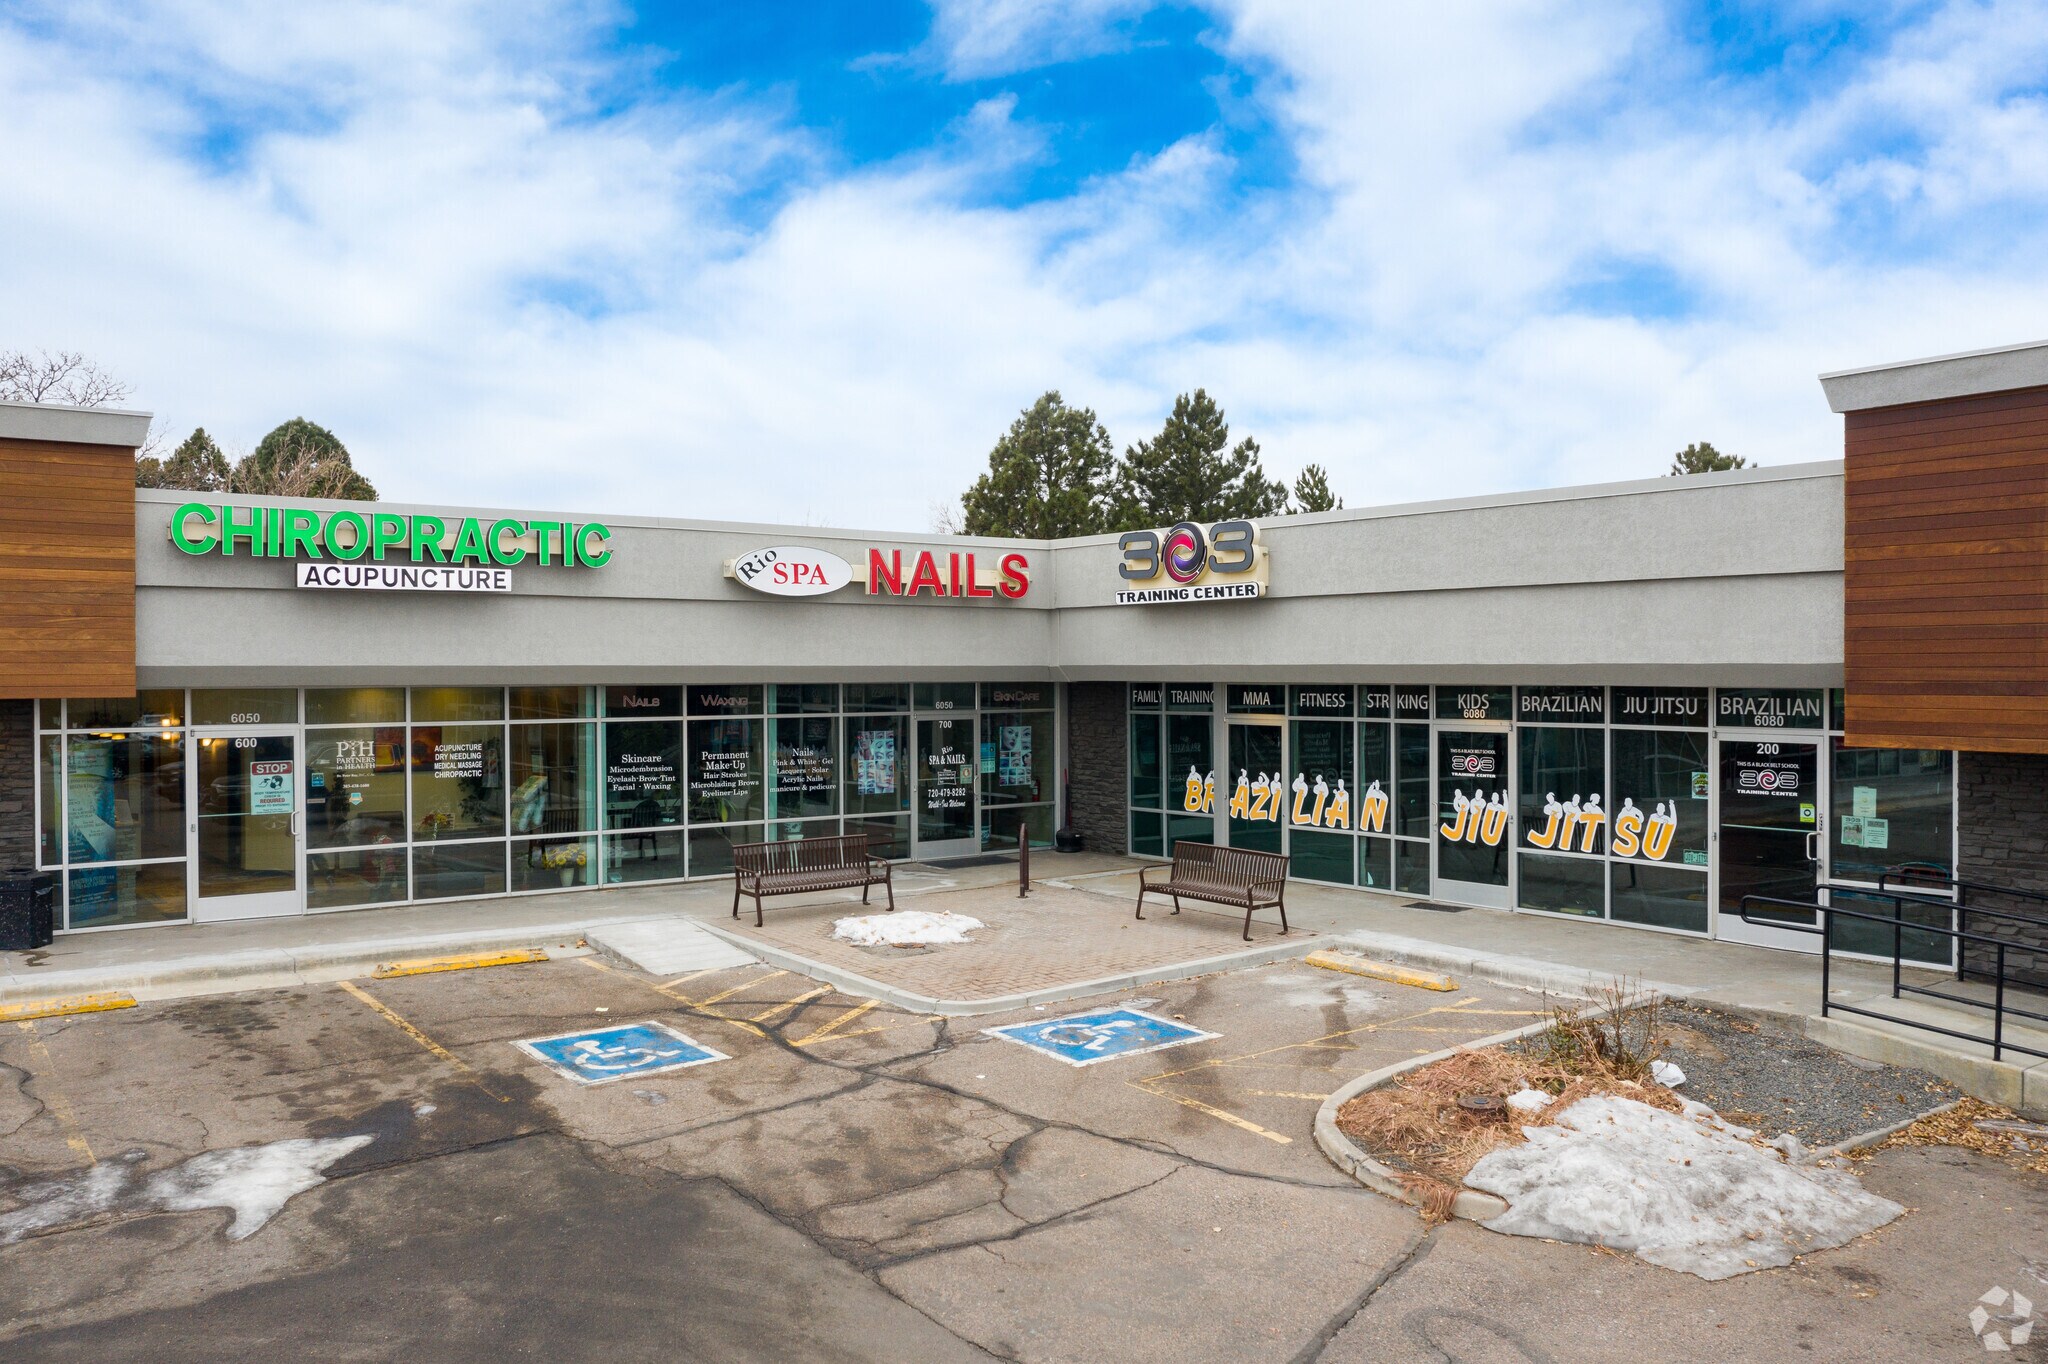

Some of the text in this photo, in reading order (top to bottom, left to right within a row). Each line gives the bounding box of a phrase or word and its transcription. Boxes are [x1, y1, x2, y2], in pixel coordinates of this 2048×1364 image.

[171, 502, 613, 568] CHIROPRACTIC
[1118, 520, 1255, 583] 303
[738, 550, 777, 582] Rio
[304, 566, 507, 589] ACUPUNCTURE
[773, 562, 830, 586] SPA
[867, 548, 1030, 598] NAILS
[1117, 584, 1256, 603] TRAINING CENTER
[1133, 690, 1163, 703] FAMILY
[1243, 692, 1271, 706] MMA
[1300, 693, 1345, 708] FITNESS
[1367, 694, 1428, 709] STRKING
[1458, 694, 1489, 710] KIDS
[1522, 696, 1602, 712] BRAZILIAN
[1623, 697, 1698, 715] JIU JITSU
[1721, 698, 1820, 716] BRAZILIAN
[231, 713, 260, 723] 6050
[1464, 709, 1485, 718] 6080
[1754, 716, 1784, 726] 6080
[235, 738, 257, 748] 600
[1756, 743, 1779, 754] 200
[702, 751, 749, 760] Permanent
[792, 748, 814, 757] Nails
[941, 746, 953, 754] Rio
[621, 754, 662, 763] Skincare
[929, 754, 965, 765] SPA & NAILS
[1452, 755, 1495, 772] 303
[256, 764, 288, 774] STOP
[610, 765, 673, 773] Microdembrasion
[706, 761, 746, 770] Make-Up
[435, 770, 482, 778] CHIROPRACTIC
[1740, 769, 1798, 790] 303
[691, 781, 736, 789] Microblading
[928, 788, 966, 797] 720-479-8282
[1440, 803, 1509, 846] JIU
